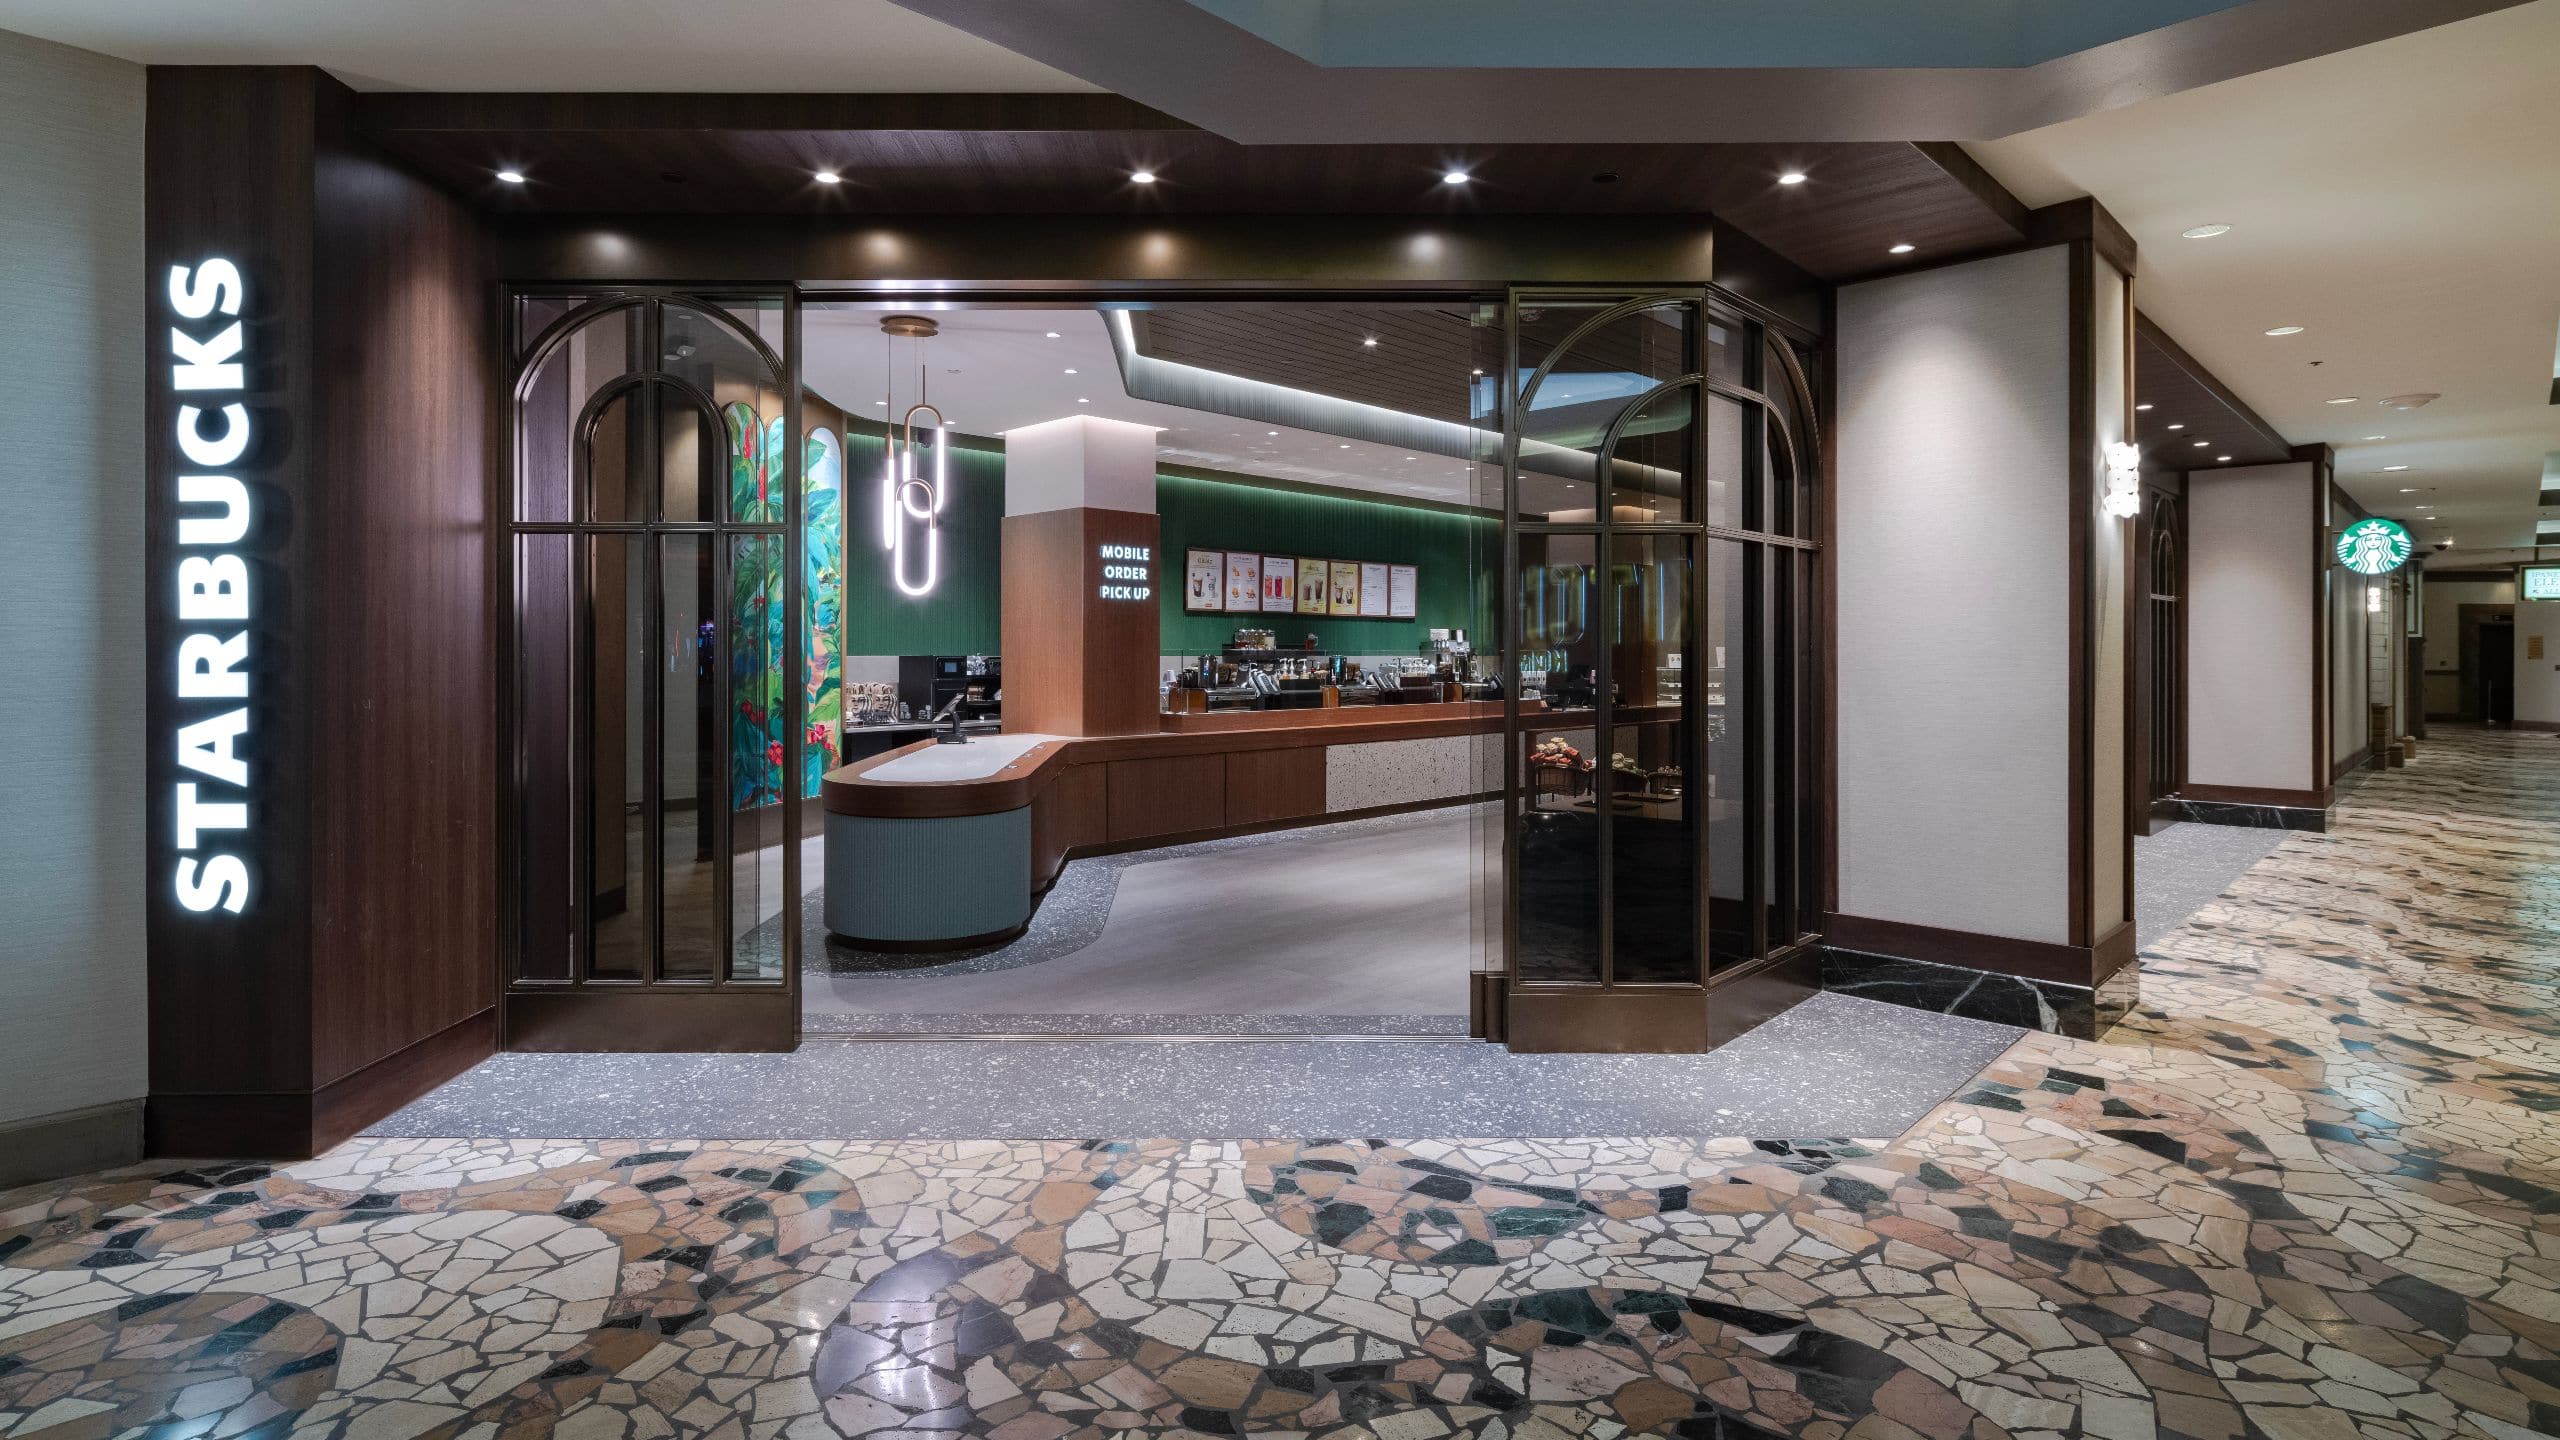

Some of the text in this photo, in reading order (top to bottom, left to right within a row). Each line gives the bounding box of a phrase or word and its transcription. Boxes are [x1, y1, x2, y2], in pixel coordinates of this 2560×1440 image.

[1101, 545, 1150, 561] MOBILE
[1104, 565, 1148, 580] ORDER
[168, 256, 252, 915] STARBUCKS
